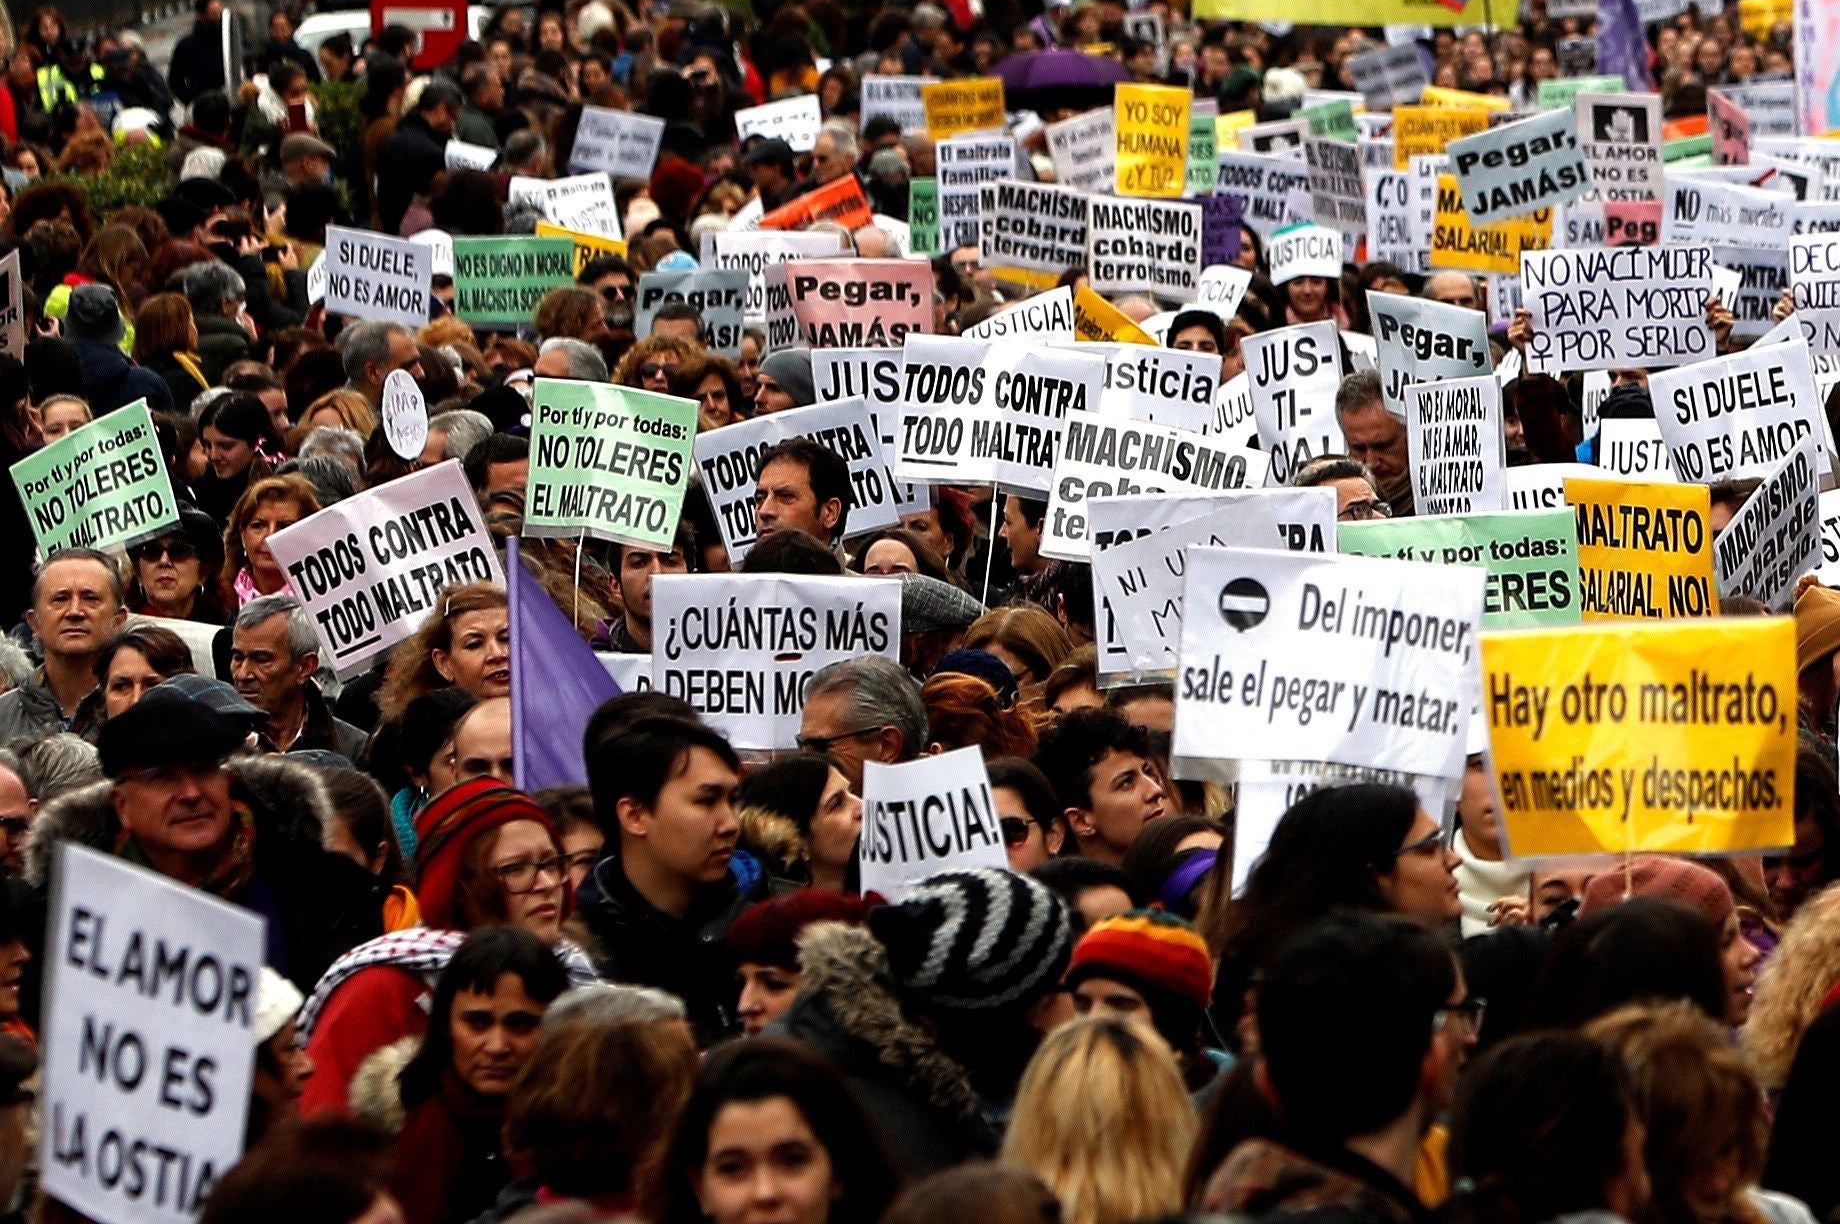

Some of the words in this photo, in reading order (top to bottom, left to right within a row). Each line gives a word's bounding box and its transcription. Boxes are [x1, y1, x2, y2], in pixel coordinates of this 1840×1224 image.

[1124, 101, 1146, 122] YO
[1151, 102, 1181, 127] SOY
[1118, 134, 1181, 157] HUMANA
[1456, 126, 1577, 177] Pegar,
[1606, 147, 1658, 161] AMOR
[1471, 164, 1591, 218] JAMÁS!
[1592, 167, 1621, 182] NO
[1627, 168, 1648, 182] ES
[1674, 188, 1700, 222] NO
[338, 240, 363, 265] SI
[364, 242, 419, 278] DUELE,
[456, 253, 472, 277] NO
[474, 253, 487, 277] ES
[489, 253, 521, 278] DIGNO
[536, 253, 572, 278] MORAL
[1093, 236, 1197, 264] cobarde
[1524, 255, 1570, 289] NO
[1793, 243, 1822, 274] DE
[328, 273, 351, 299] NO
[353, 276, 376, 302] ES
[376, 279, 428, 317] AMOR.
[795, 276, 921, 307] Pegar,
[1093, 262, 1196, 289] terrorismo.
[1540, 288, 1619, 328] PARA
[1377, 312, 1486, 369] Pegar,
[1556, 330, 1615, 363] POR
[1626, 326, 1706, 358] SERLO
[903, 362, 985, 404] TODOS
[994, 370, 1087, 419] CONTRA
[1417, 392, 1432, 425] NO
[1446, 387, 1486, 420] MORAL,
[1672, 387, 1699, 426] SI
[1703, 366, 1796, 418] DUELE,
[539, 404, 568, 425] Por
[594, 411, 629, 434] por
[632, 413, 688, 441] todas:
[901, 414, 962, 456] TODO
[24, 478, 50, 499] Por
[73, 446, 96, 474] por
[97, 422, 148, 456] todas:
[536, 434, 570, 470] NO
[573, 434, 683, 487] TOLERES
[1429, 459, 1484, 495] MALTRATO
[1672, 447, 1701, 483] NO
[1710, 435, 1734, 474] ES
[34, 496, 66, 535] NO
[64, 446, 159, 511] TOLERES
[532, 483, 554, 517] EL
[558, 484, 669, 535] MALTRATO.
[67, 494, 171, 554] MALTRATO.
[1574, 501, 1704, 556] MALTRATO
[288, 537, 367, 603] TODOS
[368, 495, 476, 565] CONTRA
[1443, 545, 1484, 565] por
[1490, 537, 1567, 560] todas:
[316, 597, 376, 652] TODO
[375, 546, 492, 627] MALTRATO
[1118, 566, 1147, 596] NI
[1579, 567, 1663, 620] SALARIAL,
[1669, 574, 1712, 618] NO!
[664, 596, 818, 661] ¿CUÁNTAS
[825, 601, 889, 653] MÁS
[1299, 582, 1347, 635] Del
[1351, 586, 1473, 664] imponer,
[663, 670, 765, 714] DEBEN
[1181, 654, 1234, 704] sale
[1240, 669, 1263, 708] el
[1268, 675, 1345, 727] pegar
[1350, 685, 1370, 732] y
[1372, 686, 1460, 736] matar.
[1489, 679, 1546, 742] Hay
[1560, 677, 1626, 726] otro
[1639, 671, 1788, 733] maltrato,
[1500, 774, 1527, 813] en
[1529, 758, 1614, 815] medios
[1618, 769, 1636, 816] y
[1641, 754, 1783, 818] despachos.
[67, 906, 110, 980] EL
[116, 929, 253, 1031] AMOR
[78, 1014, 148, 1093] NO
[158, 1045, 217, 1117] ES
[52, 1101, 90, 1177] LA
